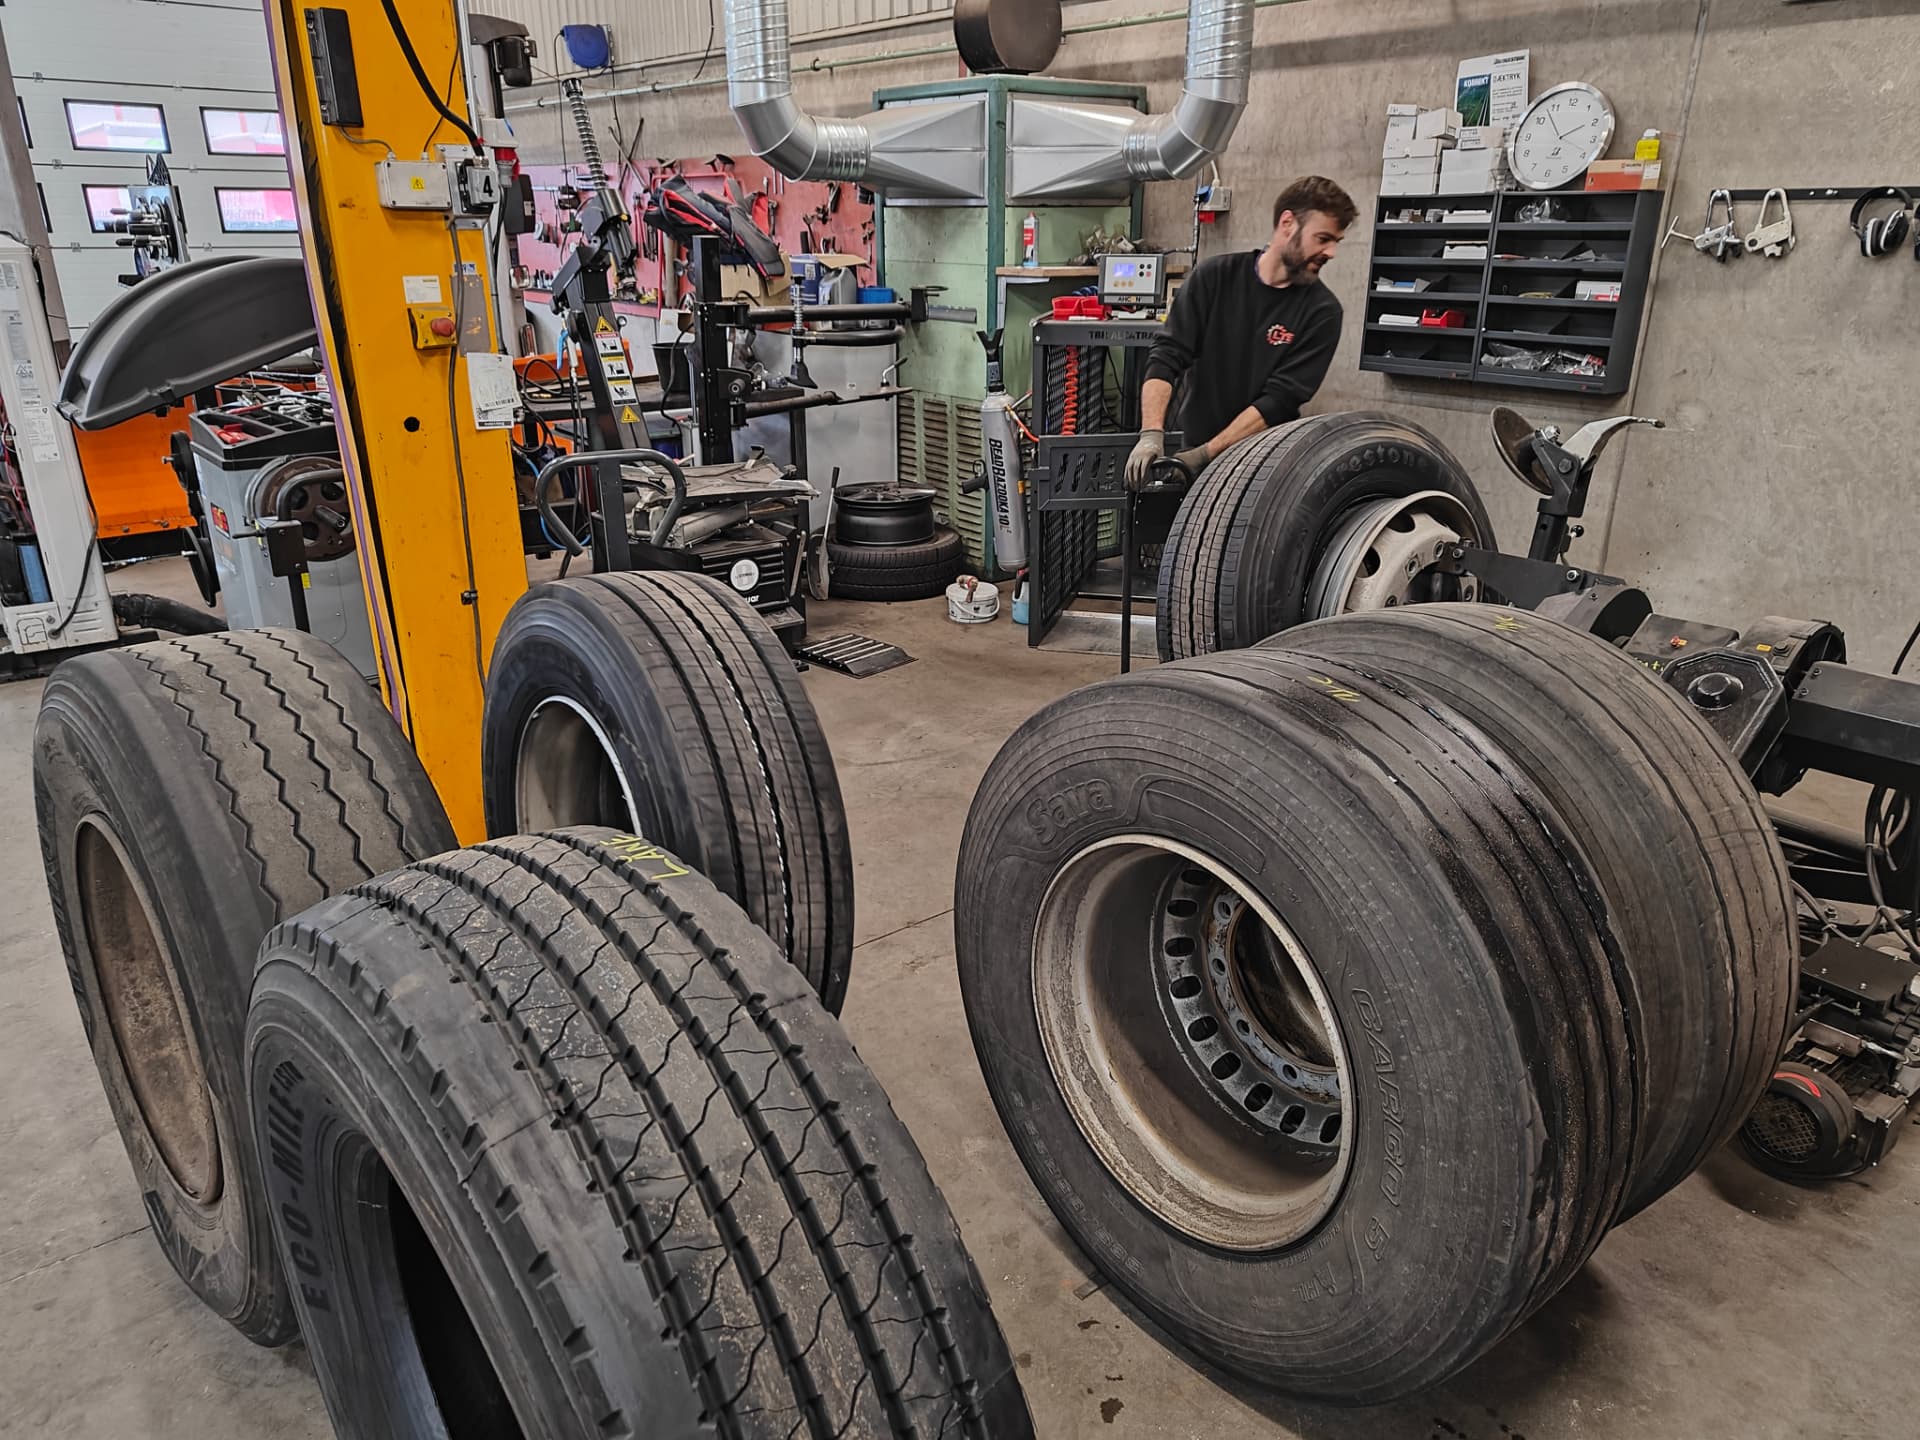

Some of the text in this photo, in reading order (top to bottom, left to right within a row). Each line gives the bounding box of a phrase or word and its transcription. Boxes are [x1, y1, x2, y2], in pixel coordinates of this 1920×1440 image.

[1569, 98, 1578, 107] 12
[1552, 104, 1560, 112] 11
[1536, 116, 1546, 125] 10
[1591, 118, 1599, 127] 2
[483, 175, 494, 197] 4
[1026, 779, 1114, 845] Sava
[1352, 987, 1407, 1262] CARGO 5
